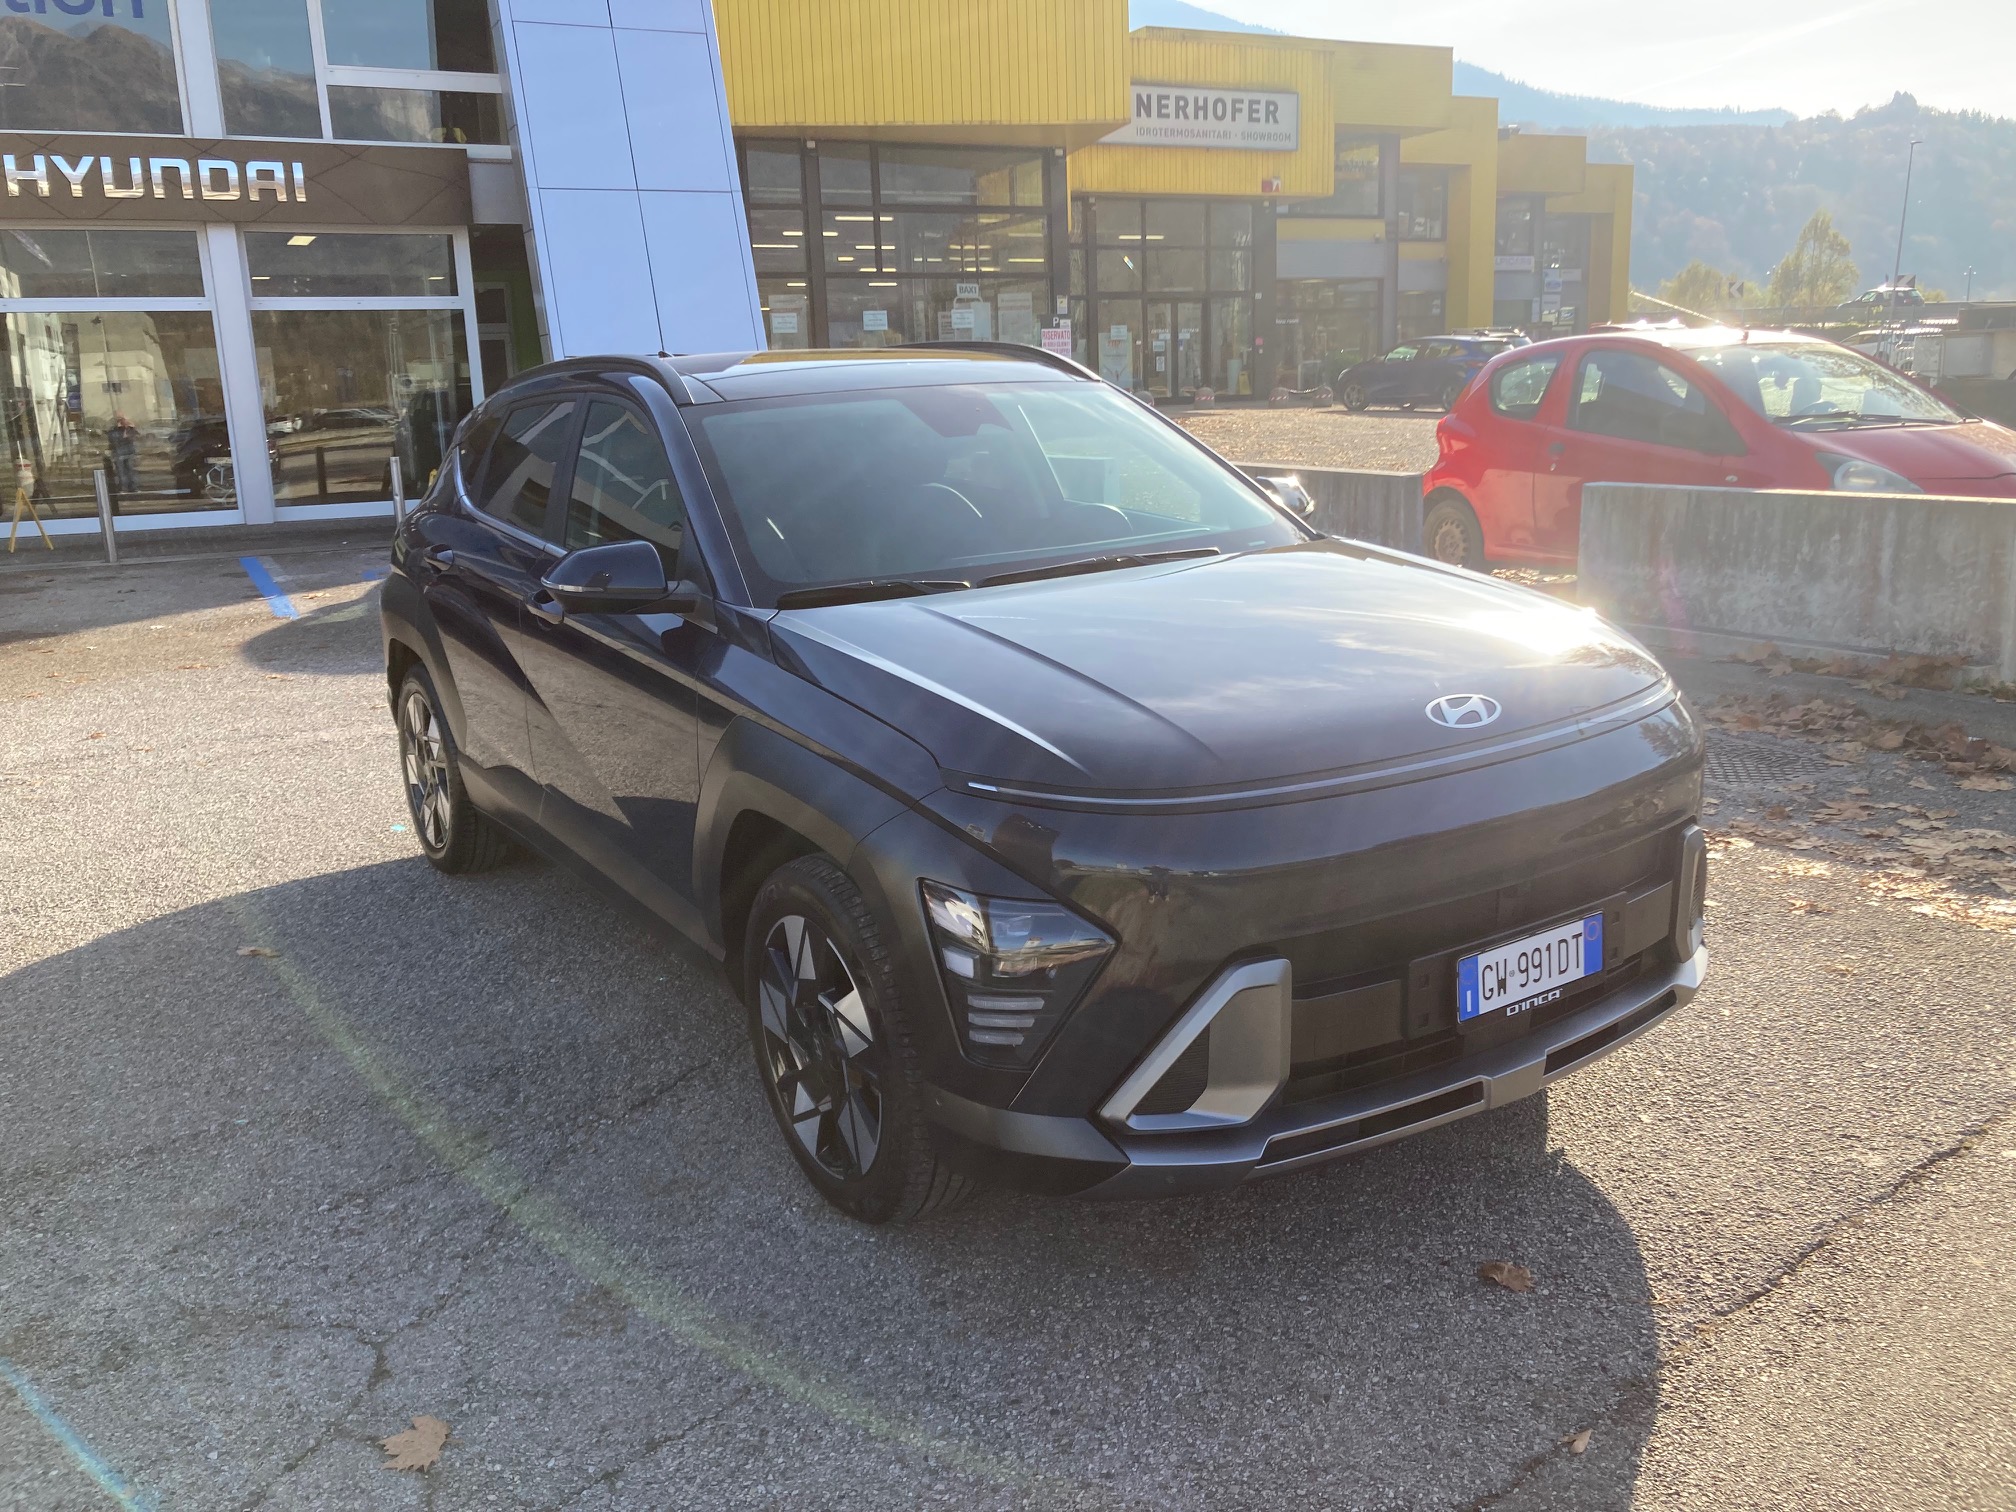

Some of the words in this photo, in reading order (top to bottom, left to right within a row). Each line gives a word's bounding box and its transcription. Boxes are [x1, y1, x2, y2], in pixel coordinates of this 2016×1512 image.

[1135, 92, 1279, 124] NERHOFER
[1136, 126, 1231, 140] IDROTERMOSANITARI
[1240, 131, 1292, 143] SHOWROOM
[3, 154, 307, 202] HYUNDAI
[959, 285, 977, 294] BAXI
[1053, 316, 1060, 328] P
[1042, 330, 1071, 341] RISERVATO
[1481, 958, 1507, 1001] GW
[1517, 932, 1583, 988] 991DT
